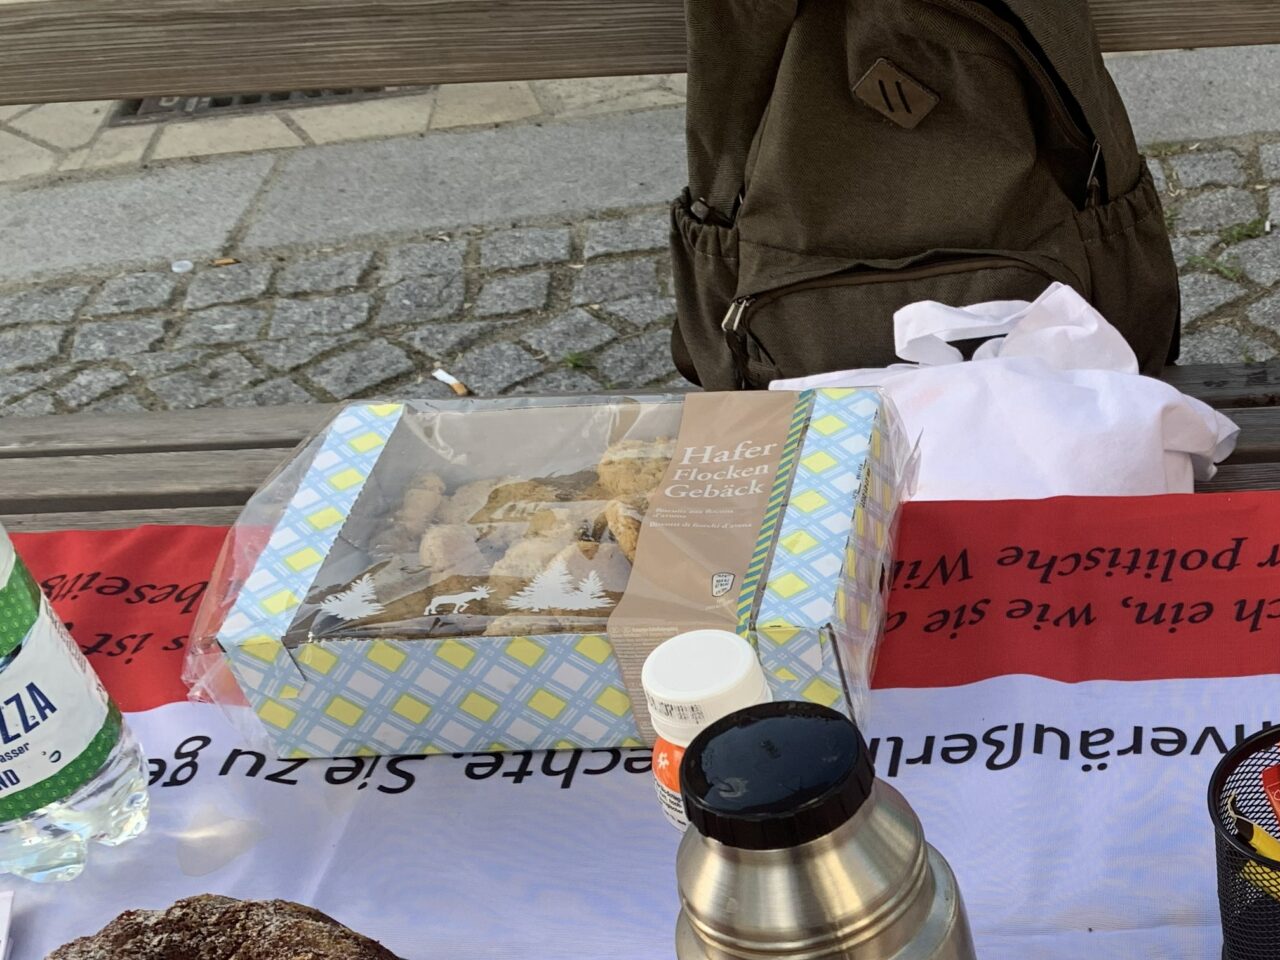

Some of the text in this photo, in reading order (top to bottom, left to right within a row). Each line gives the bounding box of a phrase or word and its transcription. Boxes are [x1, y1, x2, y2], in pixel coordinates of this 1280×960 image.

[679, 440, 778, 465] Hafer
[664, 480, 765, 498] Gebäck
[672, 464, 769, 481] Flocken
[997, 538, 1245, 583] politische
[922, 598, 991, 640] sie
[1005, 598, 1096, 633] wie
[1120, 597, 1214, 634] ein,
[80, 633, 154, 665] ist
[218, 748, 304, 786] zu
[325, 754, 426, 794] Sie
